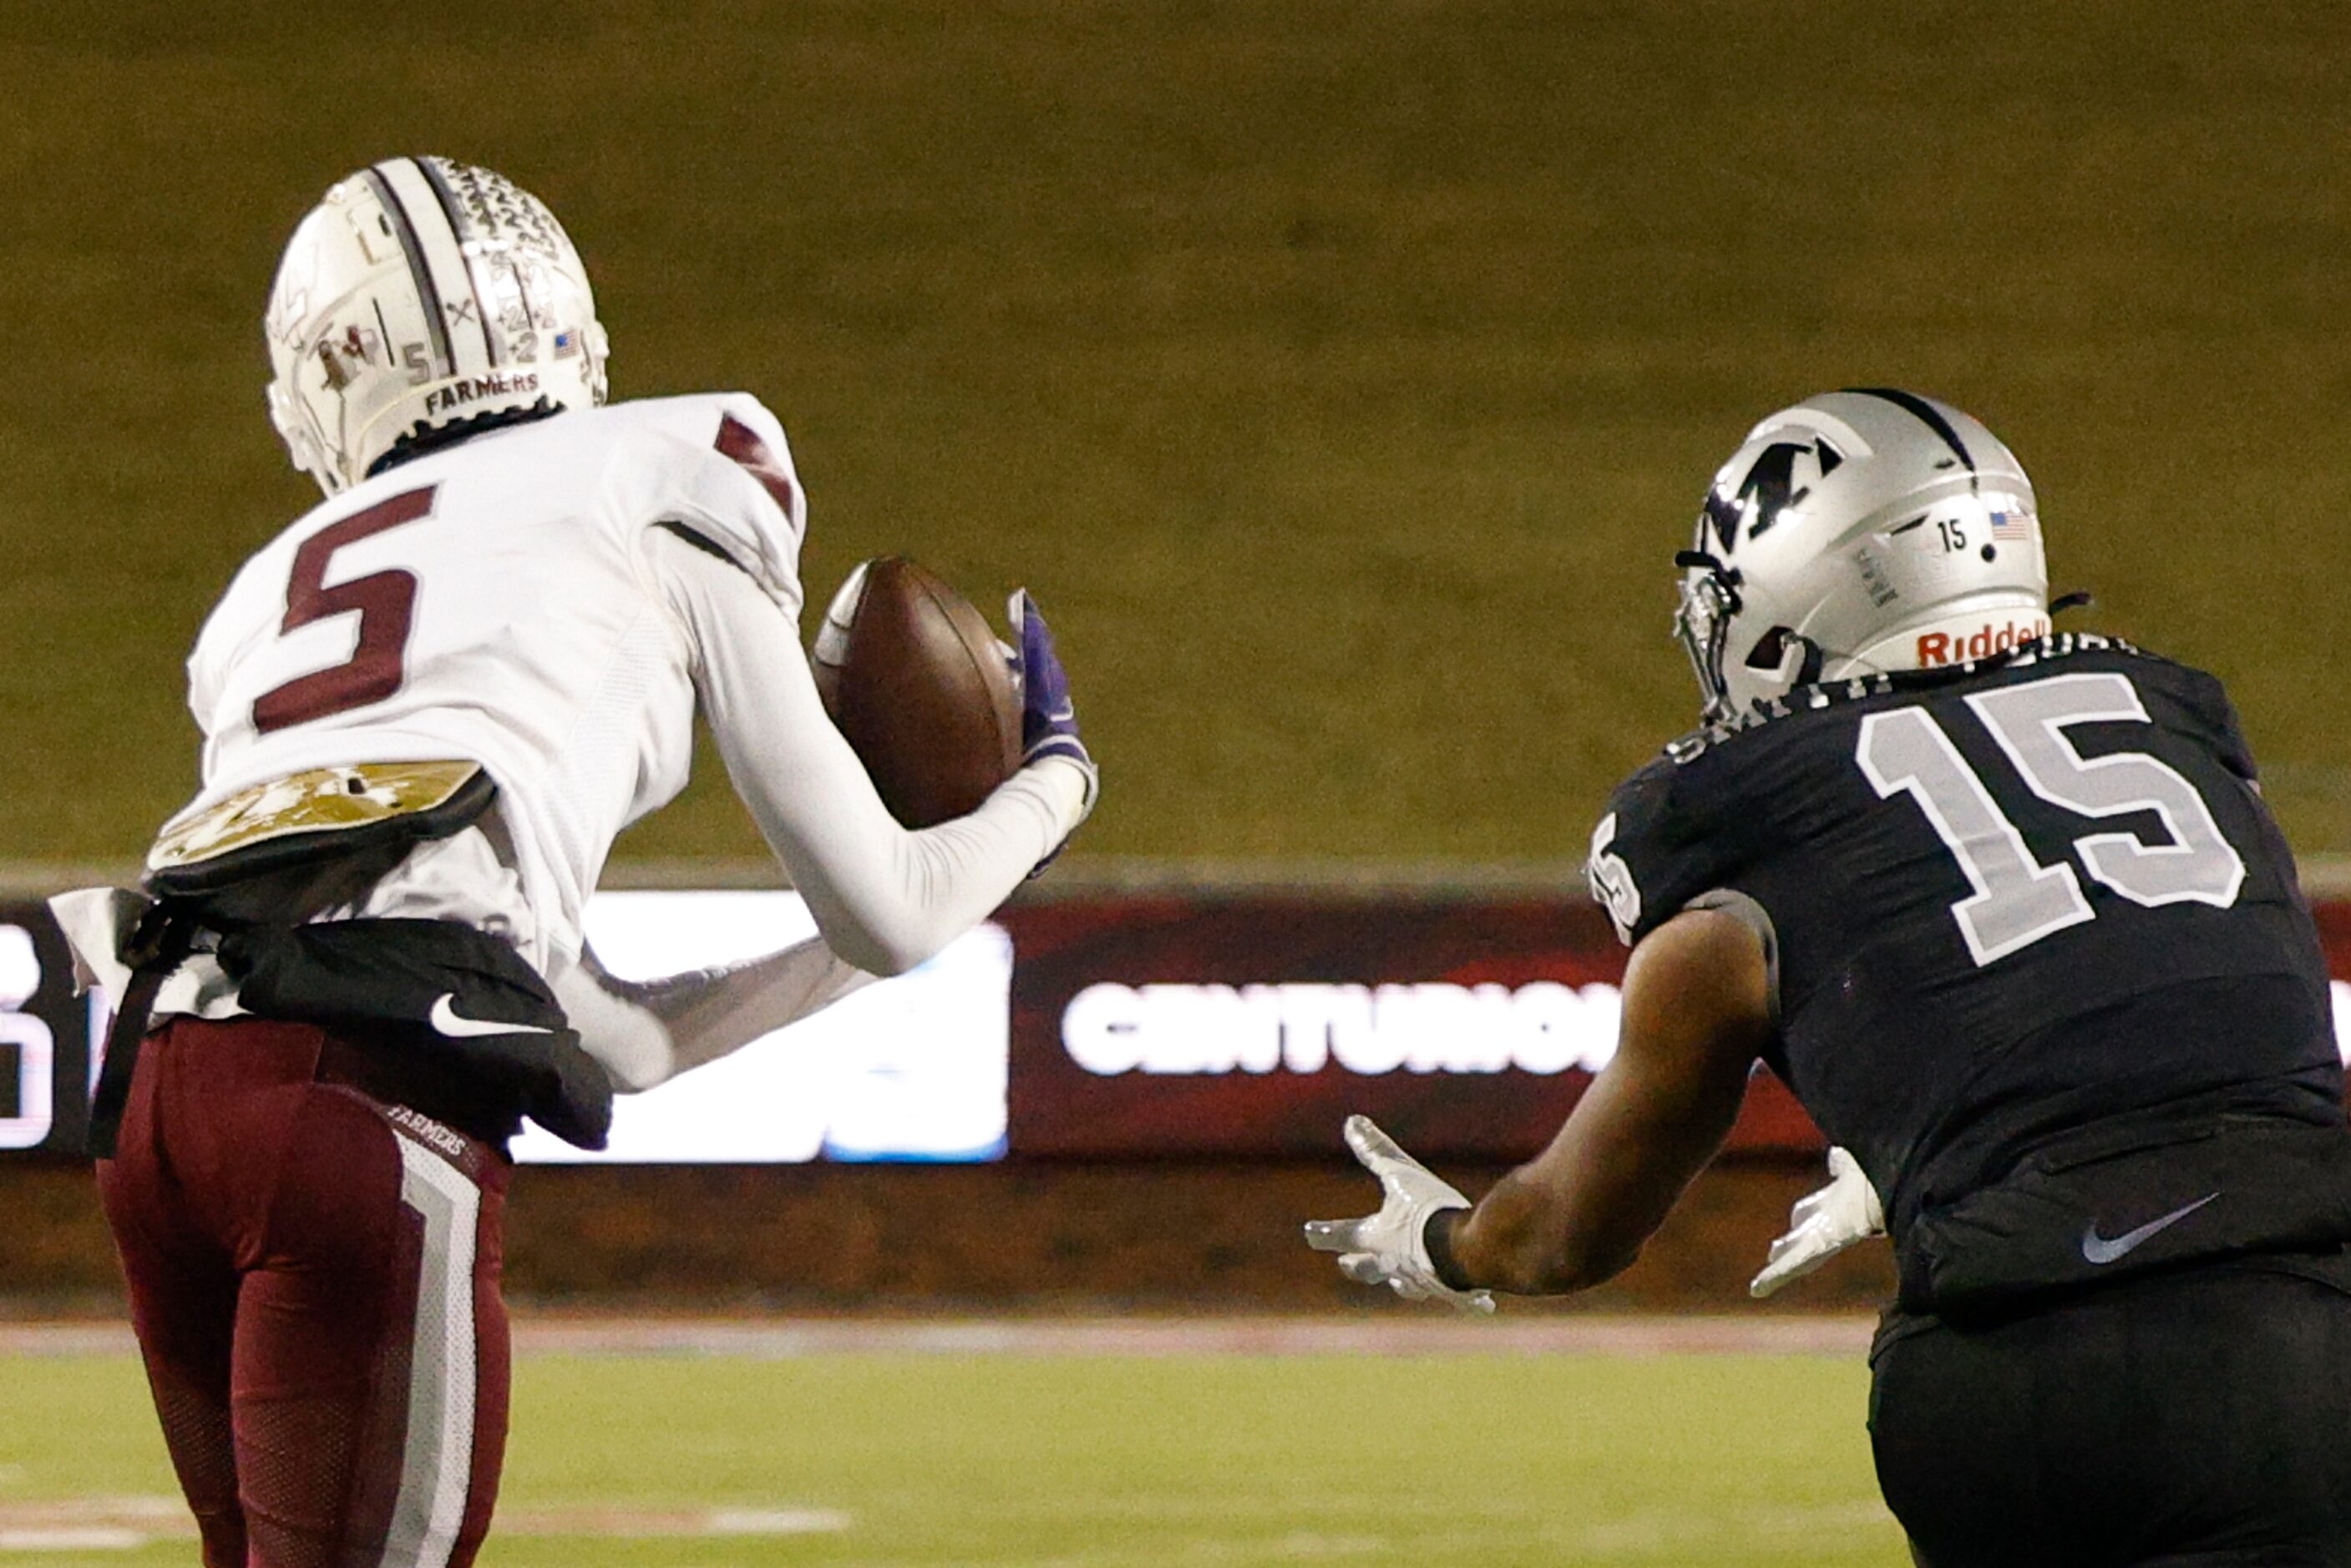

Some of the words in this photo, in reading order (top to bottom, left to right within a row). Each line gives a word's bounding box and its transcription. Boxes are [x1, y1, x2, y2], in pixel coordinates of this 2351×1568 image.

[403, 342, 431, 386] 5
[425, 374, 539, 416] FARMERS
[1938, 518, 1967, 552] 15
[251, 482, 441, 736] 5
[1917, 620, 2046, 668] Riddell
[1856, 673, 2247, 966] 15
[387, 1105, 466, 1156] FARMERS
